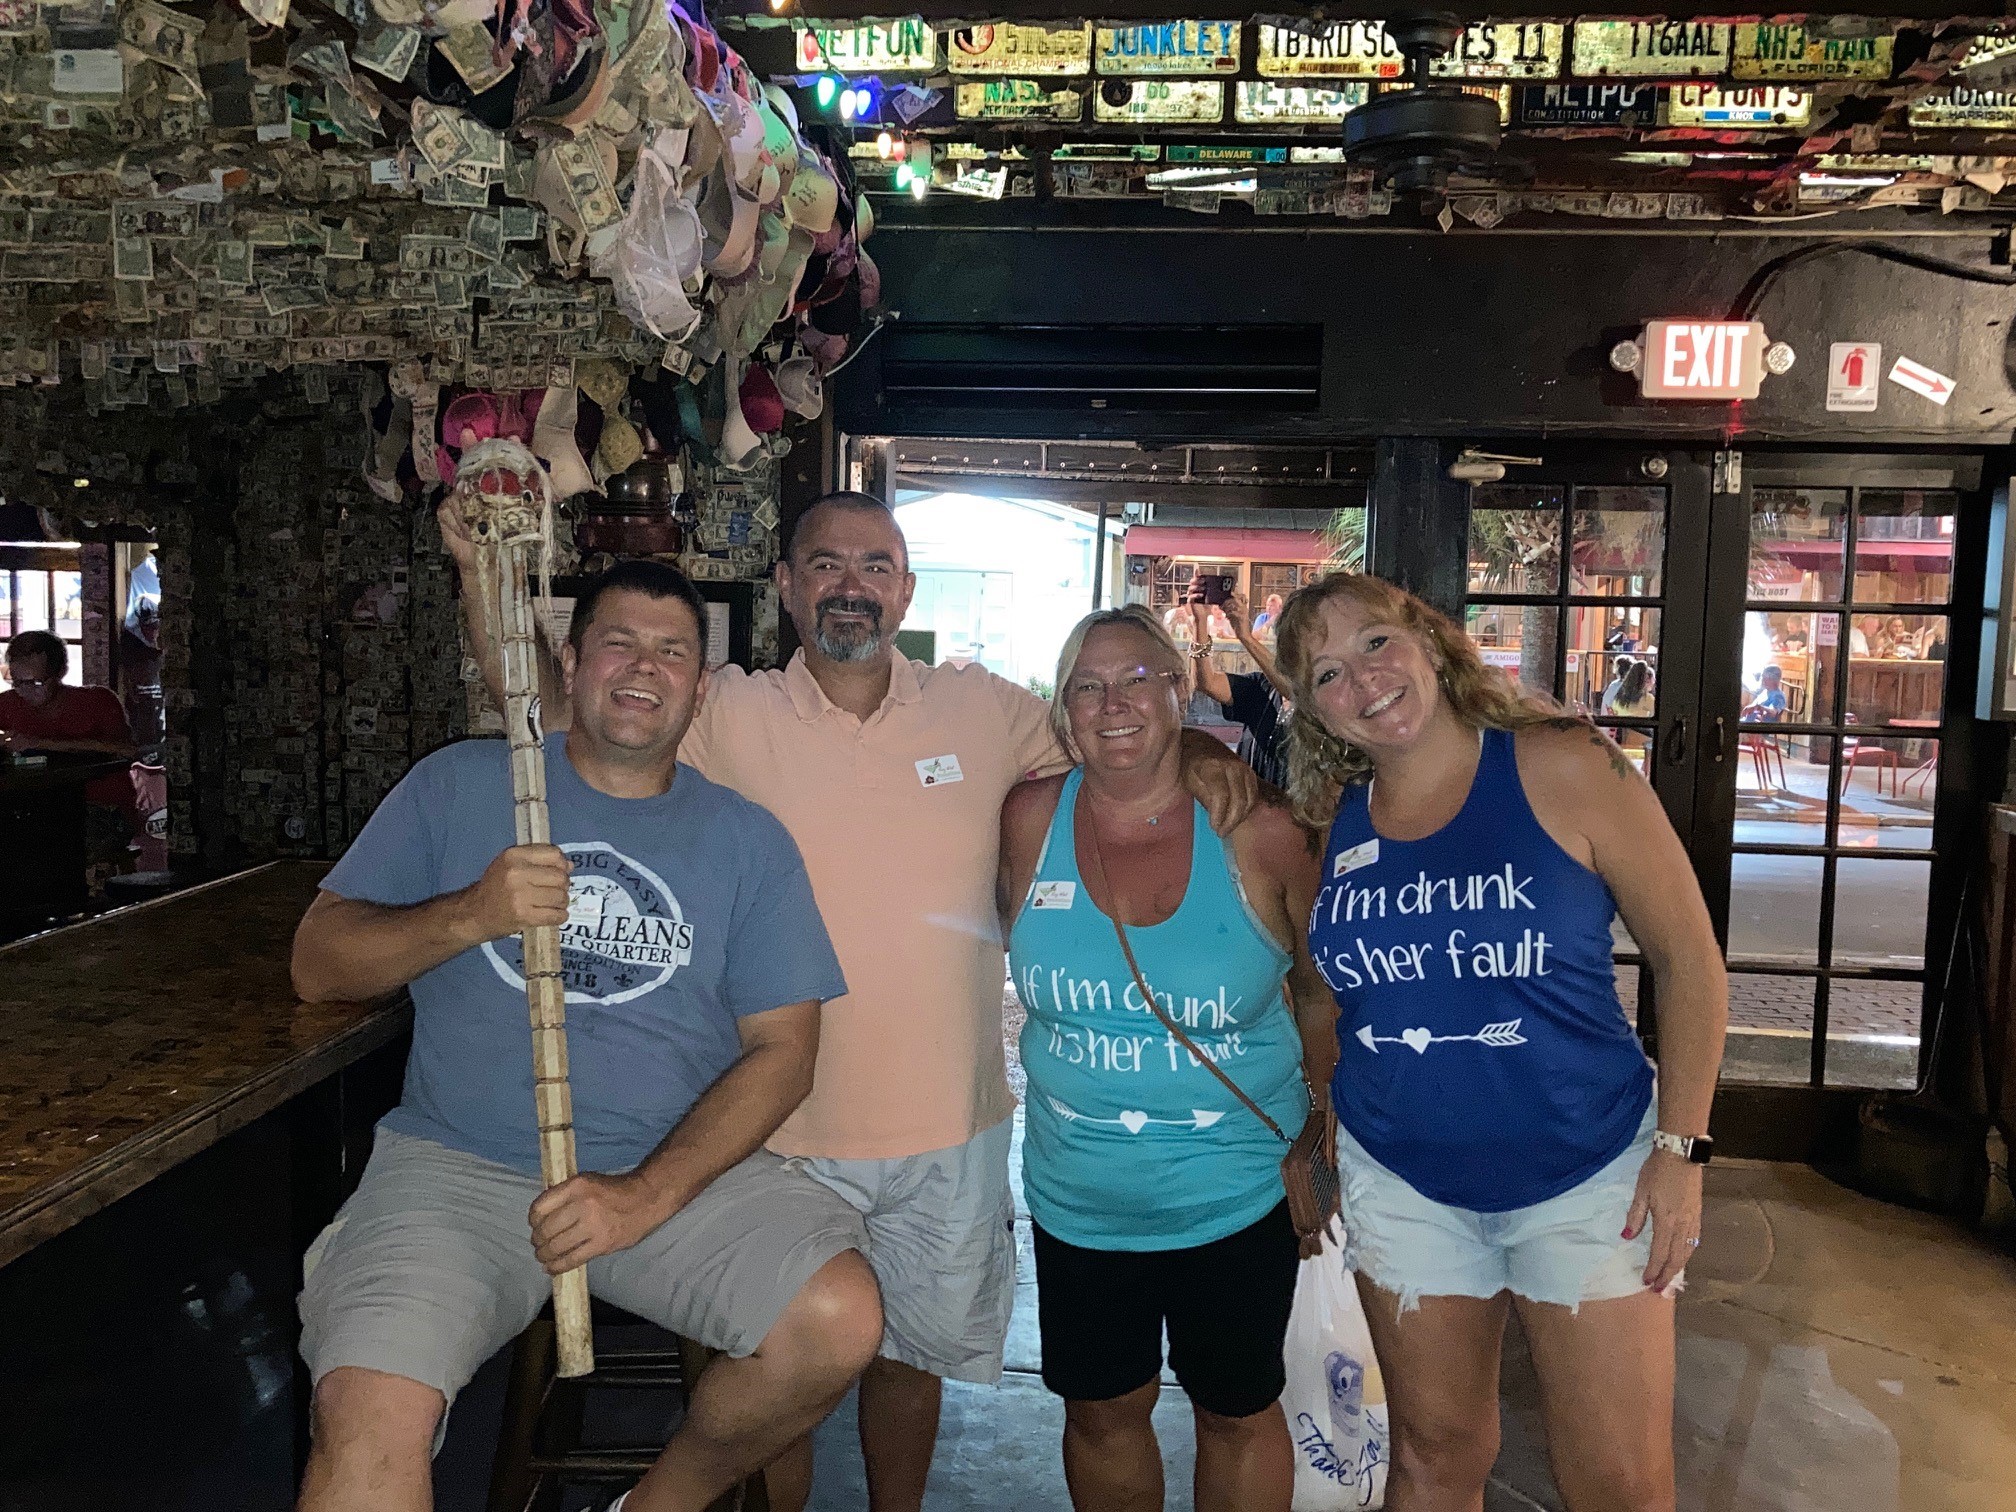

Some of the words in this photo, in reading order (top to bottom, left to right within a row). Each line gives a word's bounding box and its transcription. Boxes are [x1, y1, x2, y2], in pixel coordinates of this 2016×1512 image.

[1728, 111, 1754, 120] KNOX
[1199, 149, 1253, 160] DELAWARE
[1662, 325, 1750, 388] EXIT
[570, 853, 610, 869] BIG
[616, 862, 665, 917] EASY
[1331, 881, 1386, 924] I'm
[1396, 863, 1536, 915] drunk
[580, 939, 673, 964] QUARTER
[1356, 938, 1433, 985] her
[1446, 928, 1553, 979] fault
[1022, 964, 1043, 1010] If
[1051, 967, 1112, 1012] I'm
[1122, 972, 1242, 1030] drunk
[1085, 1027, 1153, 1072] her
